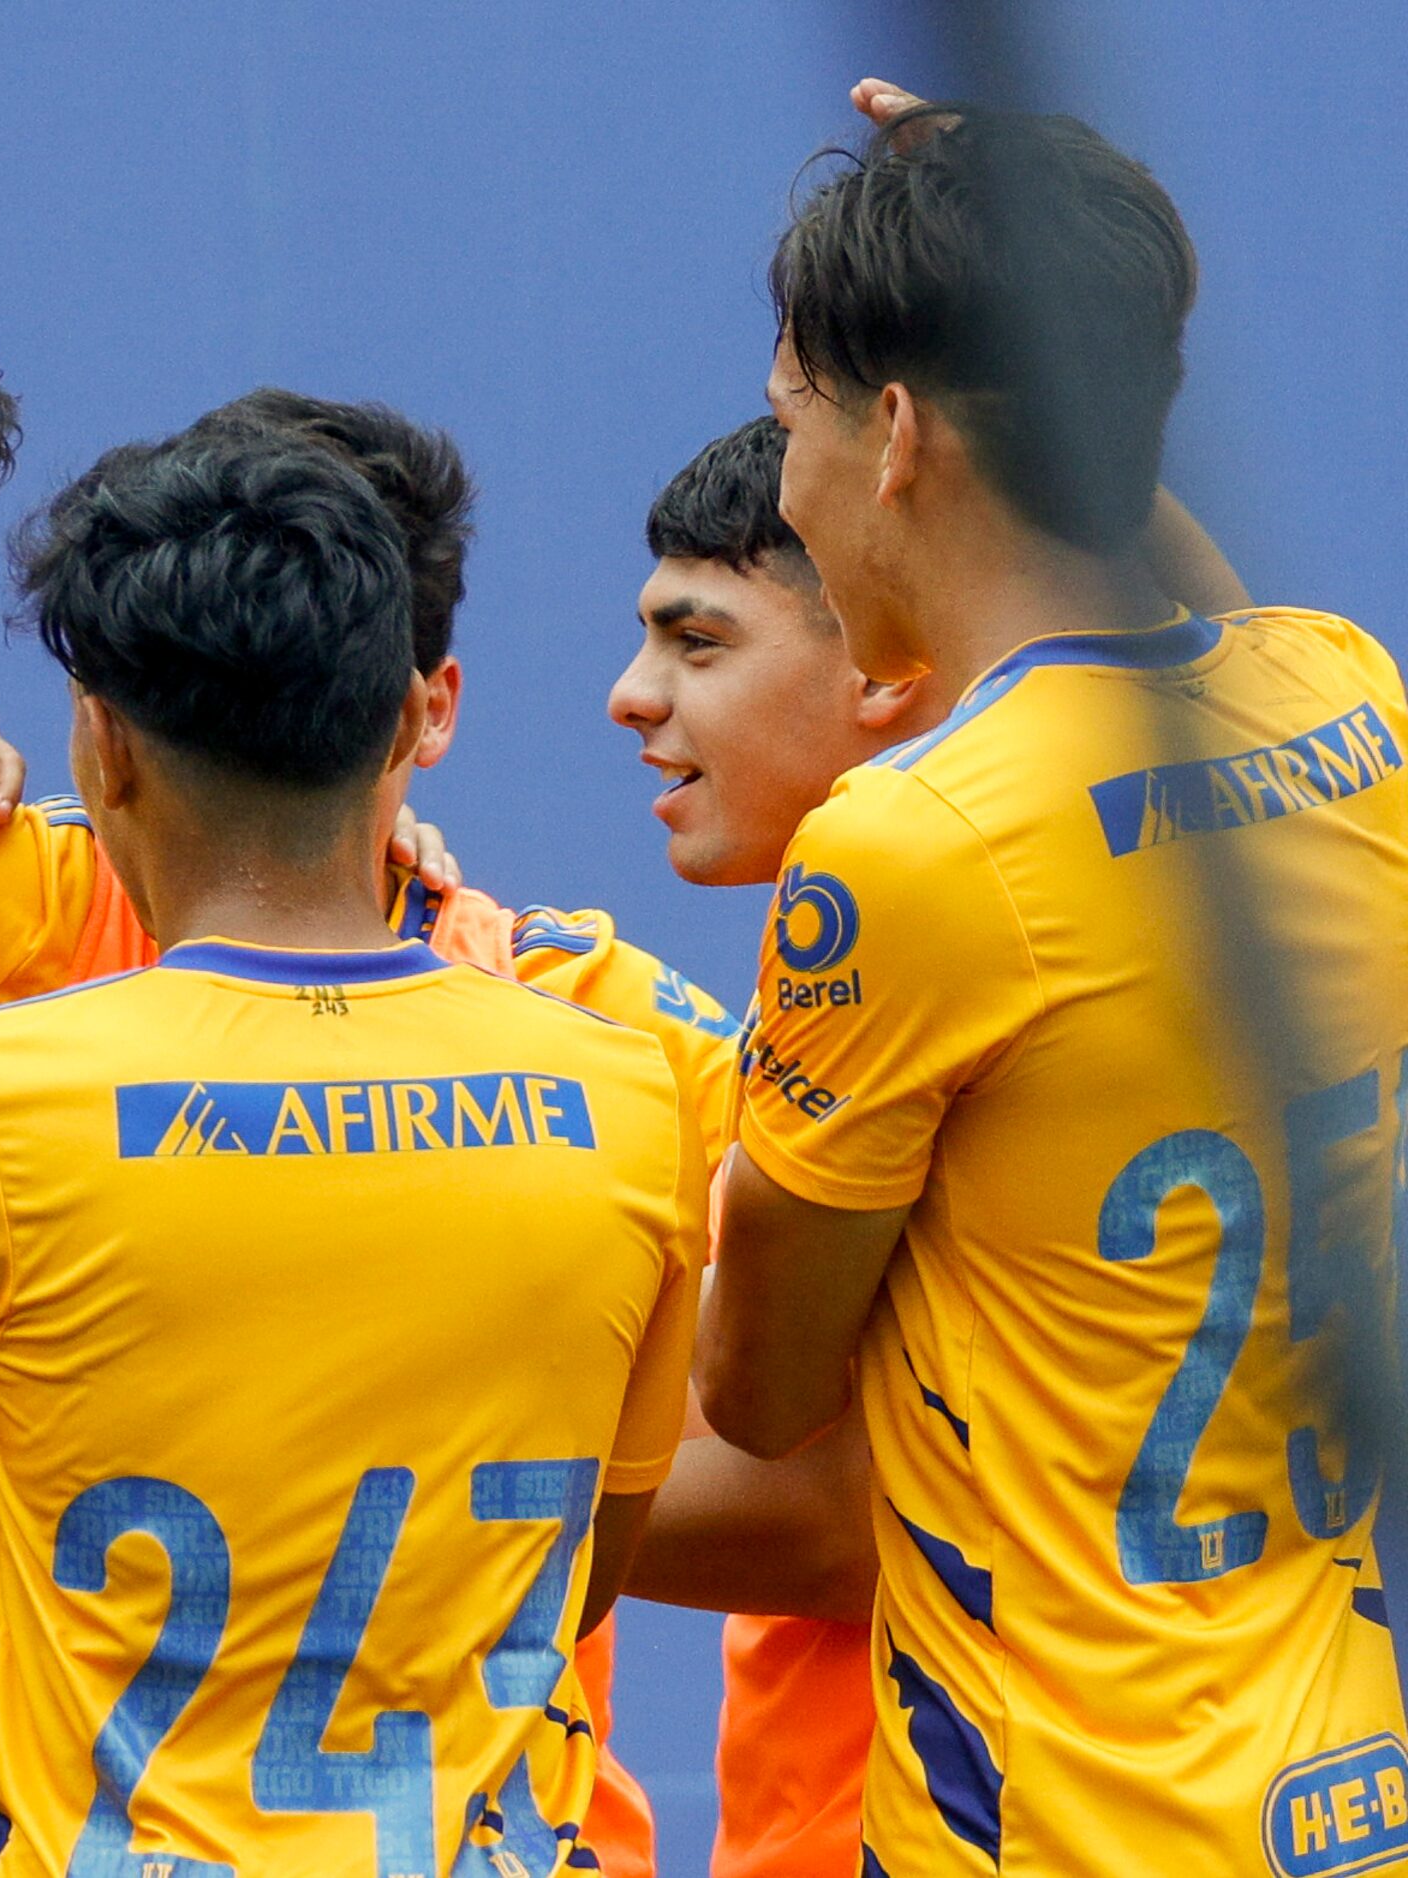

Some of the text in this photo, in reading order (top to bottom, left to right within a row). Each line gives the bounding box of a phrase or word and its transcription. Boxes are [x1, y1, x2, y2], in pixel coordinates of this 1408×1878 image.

[1207, 711, 1395, 824] AFIRME
[312, 1001, 349, 1016] 243
[778, 969, 862, 1011] Berel
[266, 1077, 570, 1155] AFIRME
